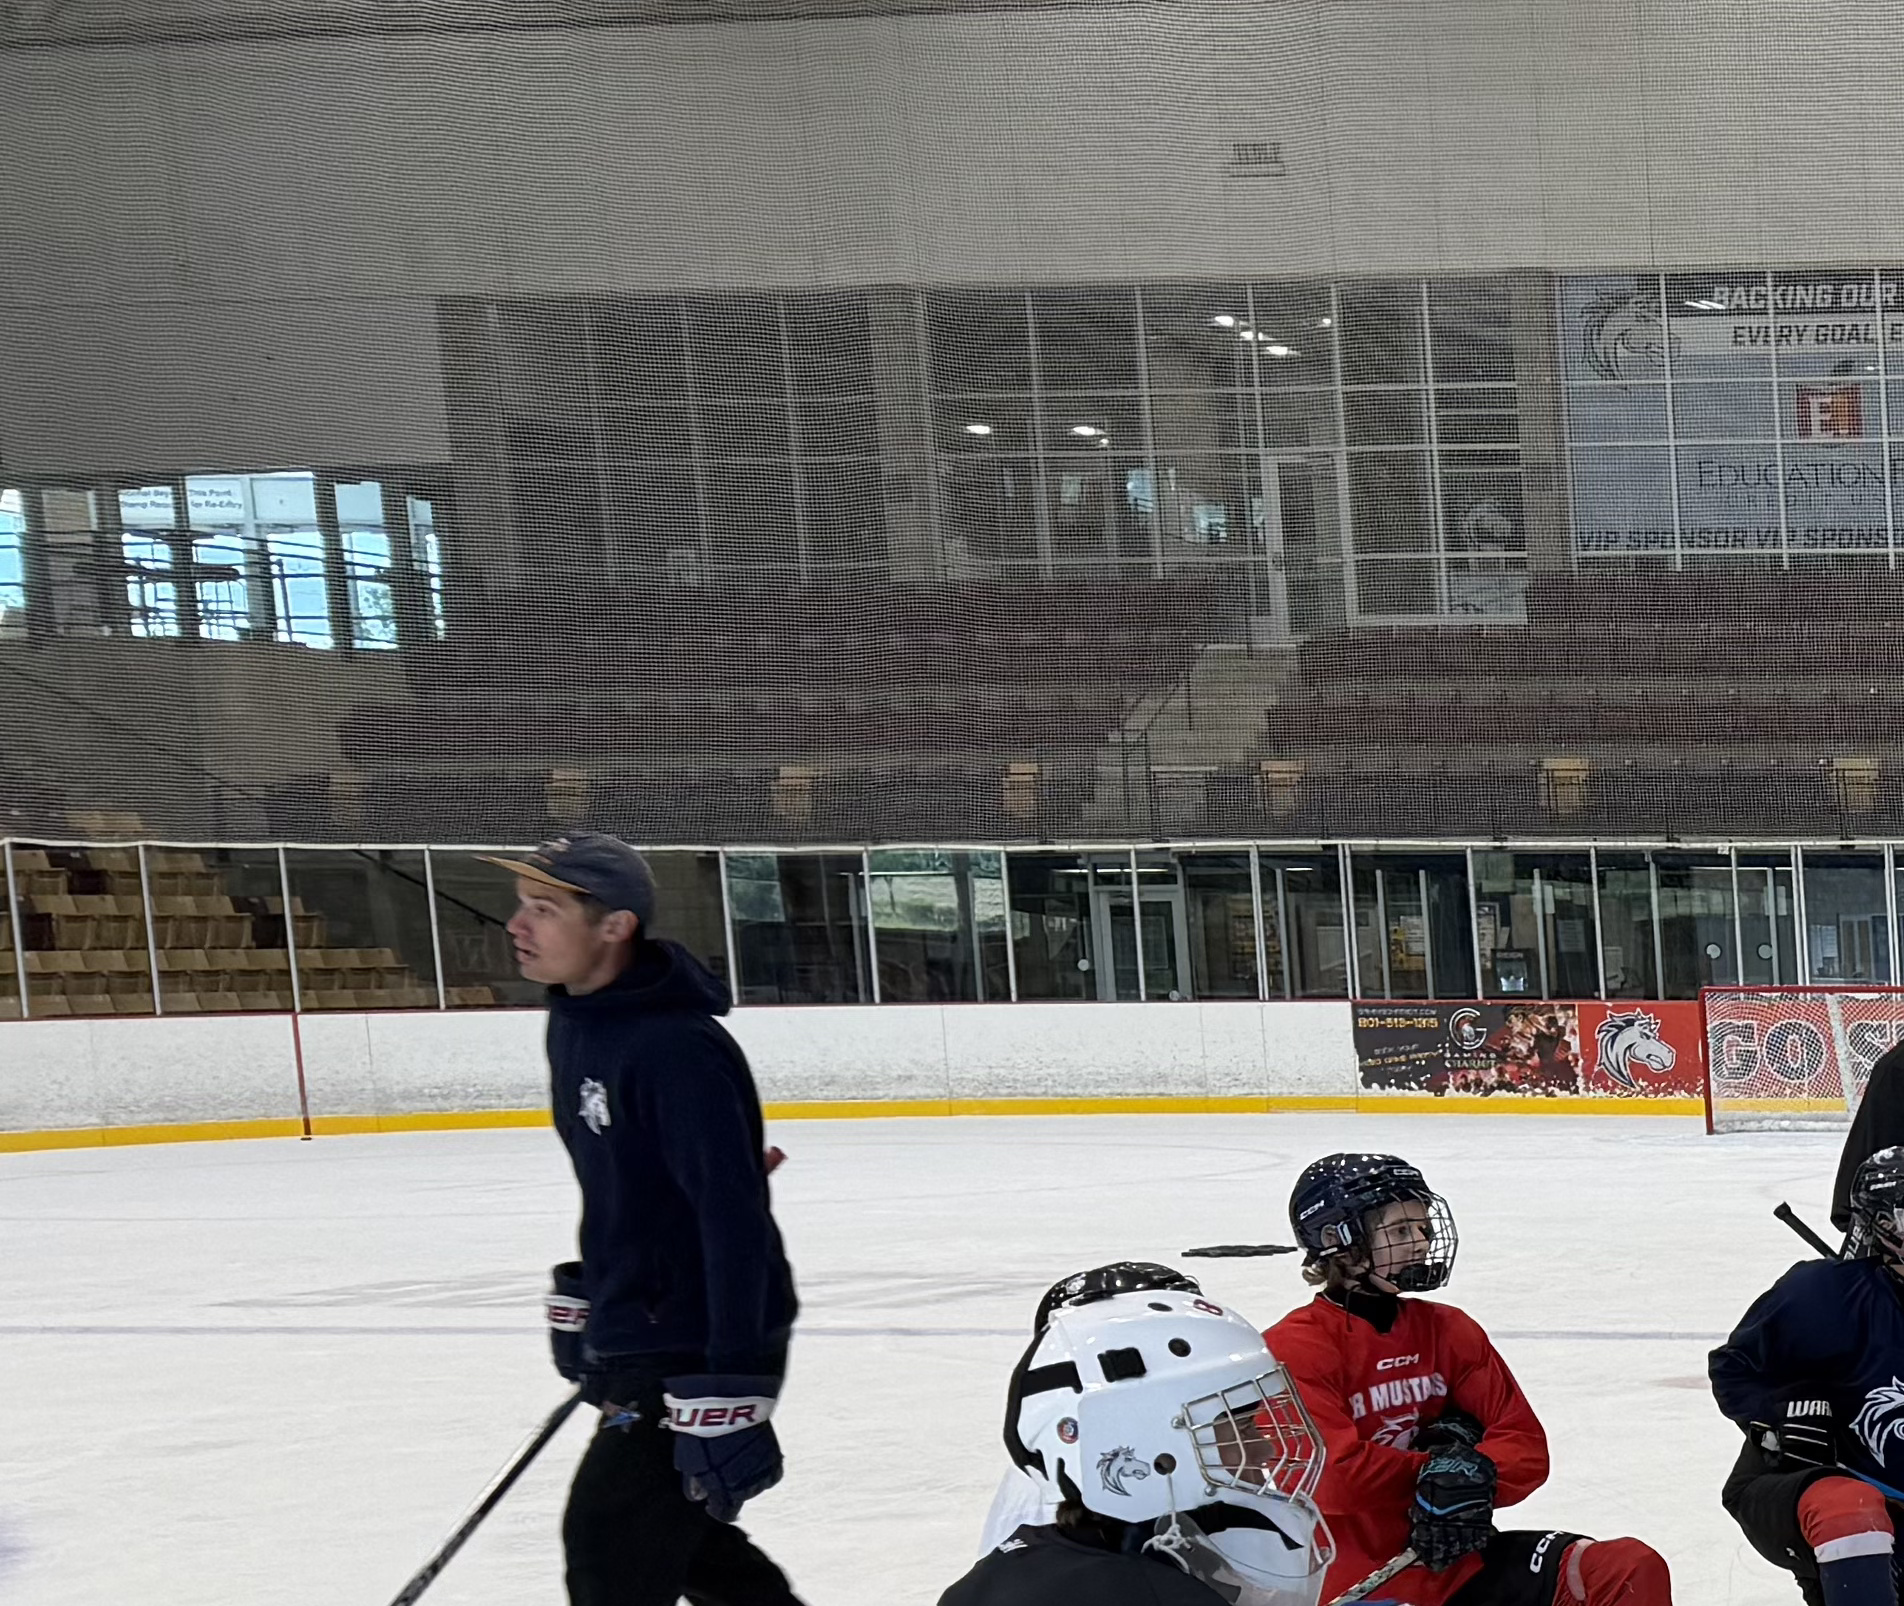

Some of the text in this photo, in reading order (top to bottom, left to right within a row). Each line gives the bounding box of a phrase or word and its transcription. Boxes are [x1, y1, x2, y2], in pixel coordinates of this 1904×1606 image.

[1713, 284, 1837, 310] BACKING
[1839, 281, 1896, 308] OUR
[1731, 323, 1809, 347] EVERY
[1578, 529, 1621, 551] VIP
[1625, 528, 1747, 550] SPONSOR
[1709, 1020, 1826, 1083] GO
[1300, 1199, 1325, 1221] CCM
[1377, 1353, 1420, 1371] CCM
